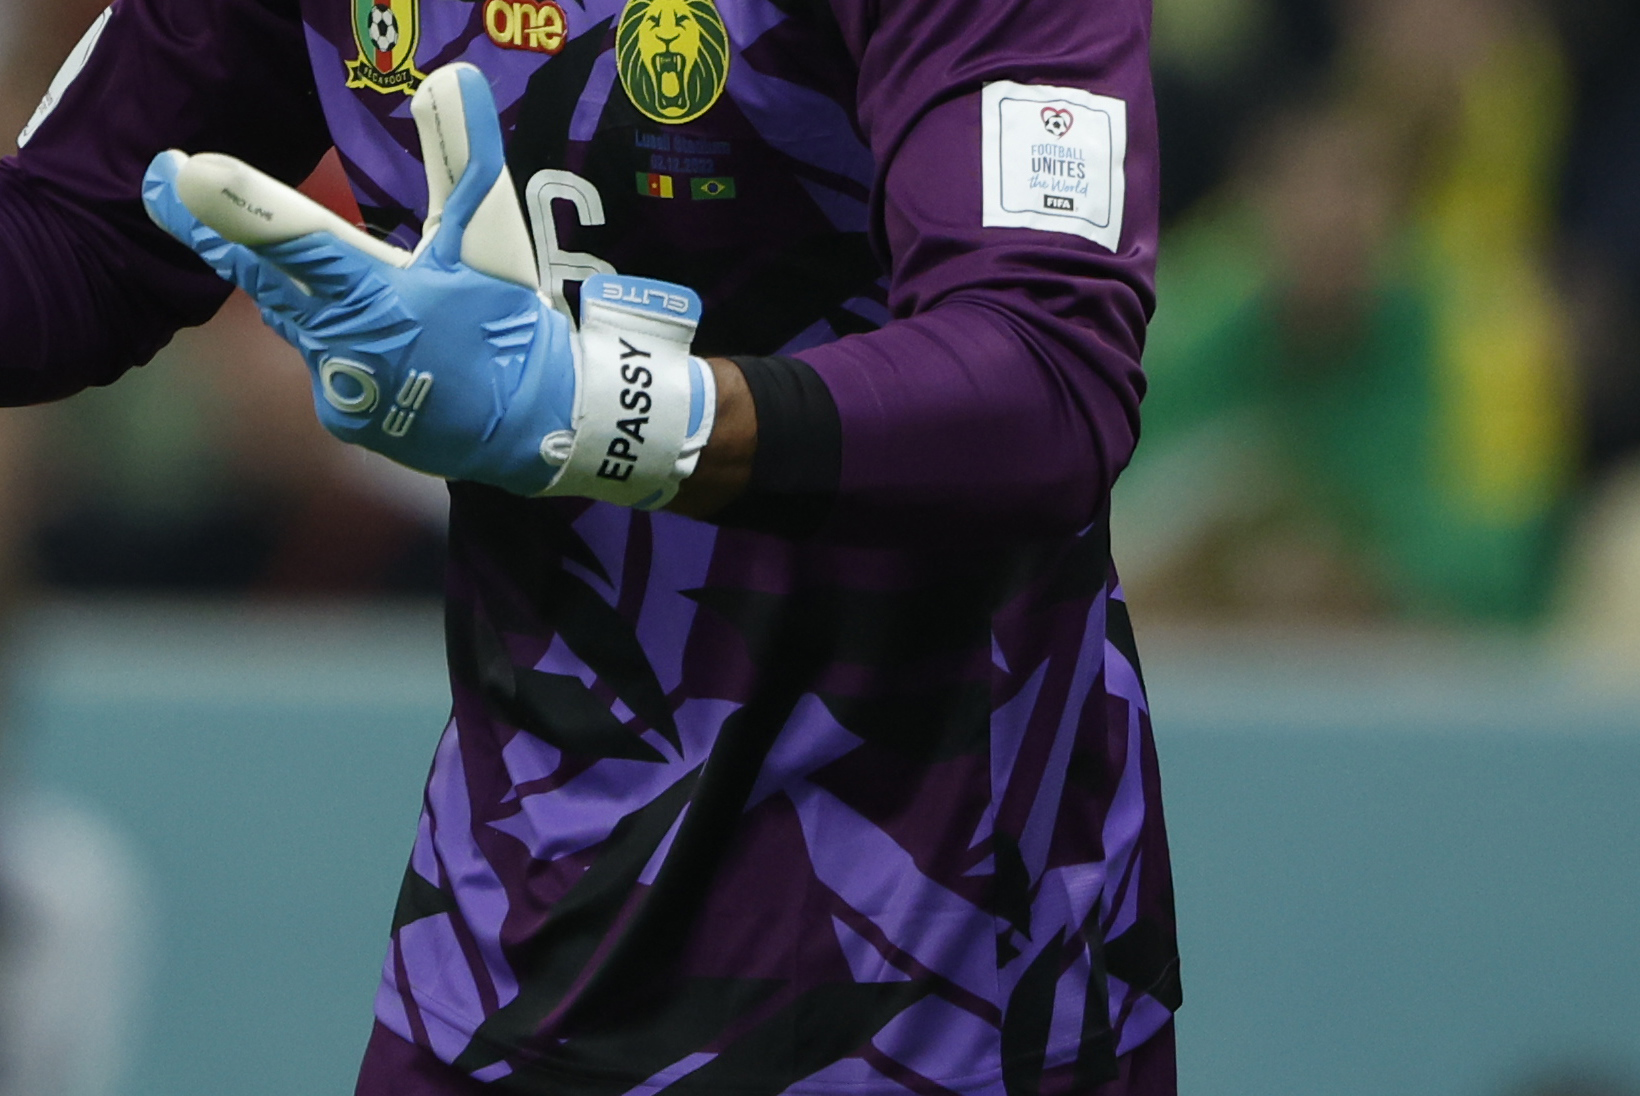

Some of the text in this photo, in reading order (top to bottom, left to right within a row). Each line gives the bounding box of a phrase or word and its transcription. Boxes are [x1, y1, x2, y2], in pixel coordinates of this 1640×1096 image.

[486, 0, 564, 50] one
[1031, 143, 1085, 160] FOOTBALL
[1032, 157, 1086, 179] UNITES
[1029, 175, 1089, 197] the World
[1047, 198, 1071, 209] FIFA
[602, 282, 689, 313] ELITE
[596, 337, 652, 482] EPASSY
